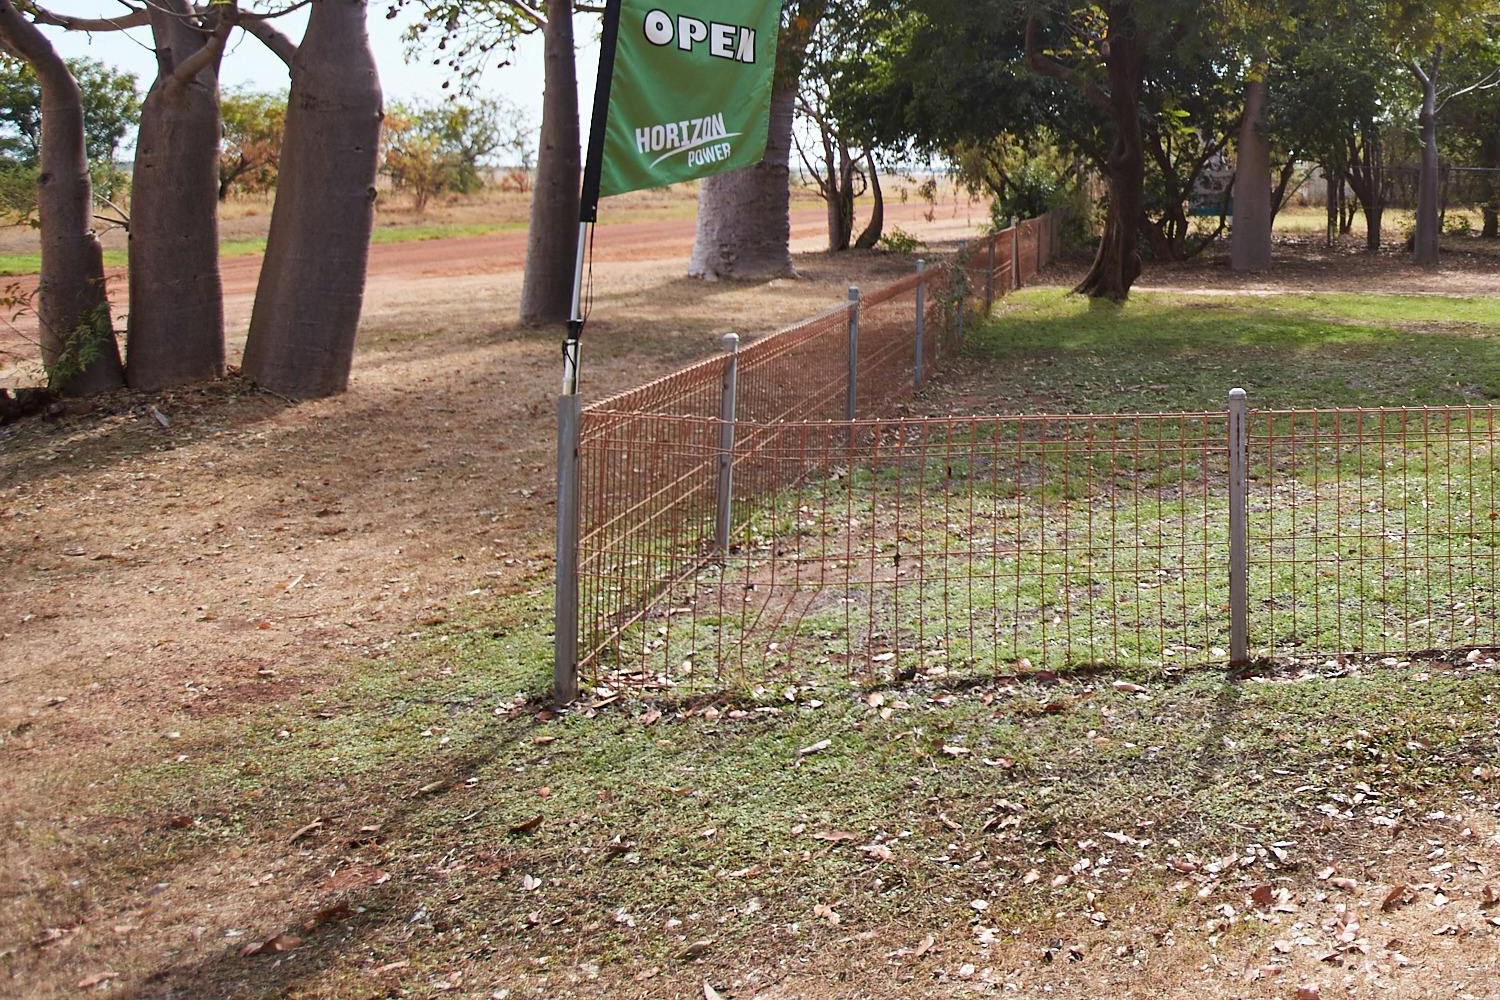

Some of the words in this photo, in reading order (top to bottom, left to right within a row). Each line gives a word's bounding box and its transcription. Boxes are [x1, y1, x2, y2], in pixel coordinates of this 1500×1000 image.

[643, 8, 756, 64] OPEN
[635, 112, 727, 154] HORIZON
[687, 142, 731, 168] POWER
